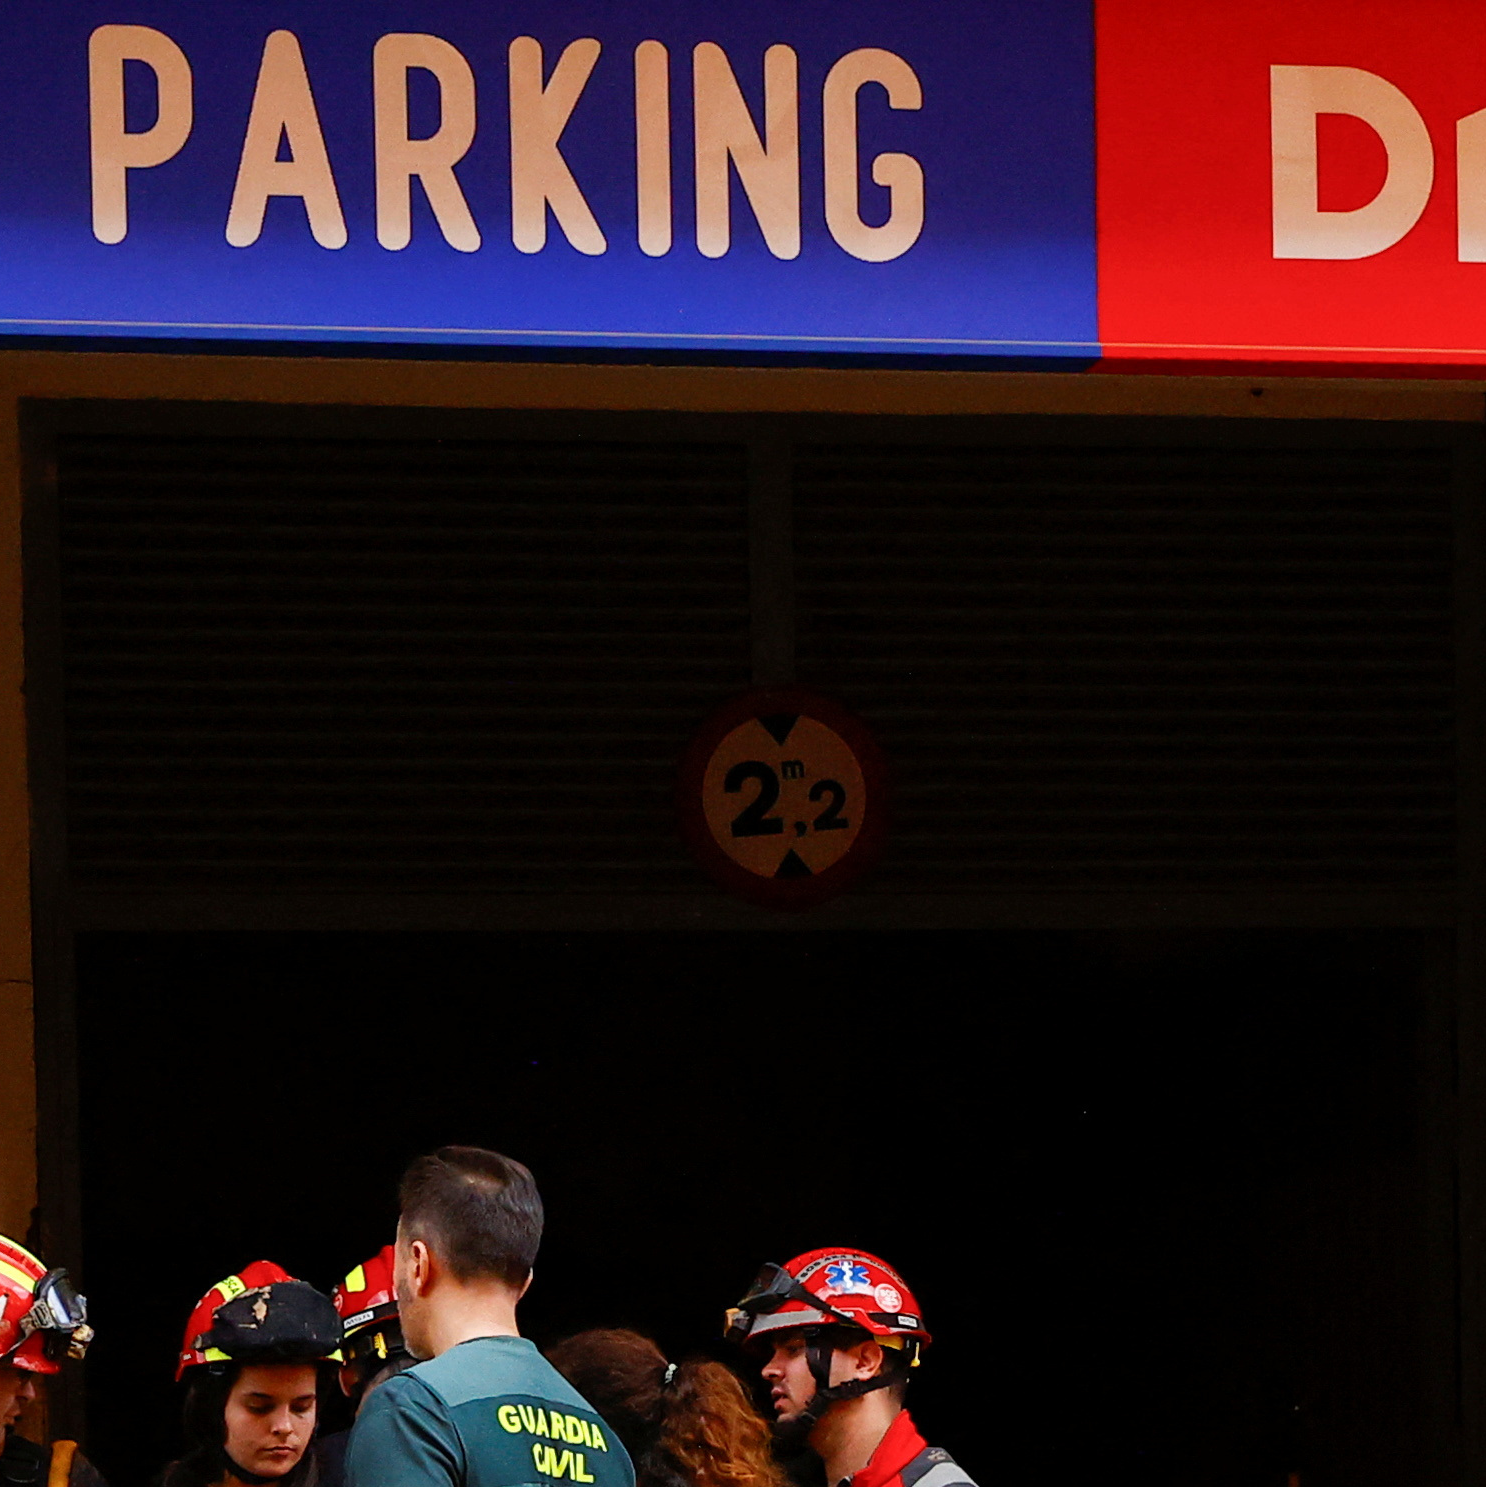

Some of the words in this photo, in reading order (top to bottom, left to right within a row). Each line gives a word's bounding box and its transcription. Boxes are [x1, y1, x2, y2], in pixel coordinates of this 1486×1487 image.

[87, 24, 926, 264] PARKING
[497, 1404, 608, 1453] GUARDIA
[532, 1442, 595, 1484] CIVIL
